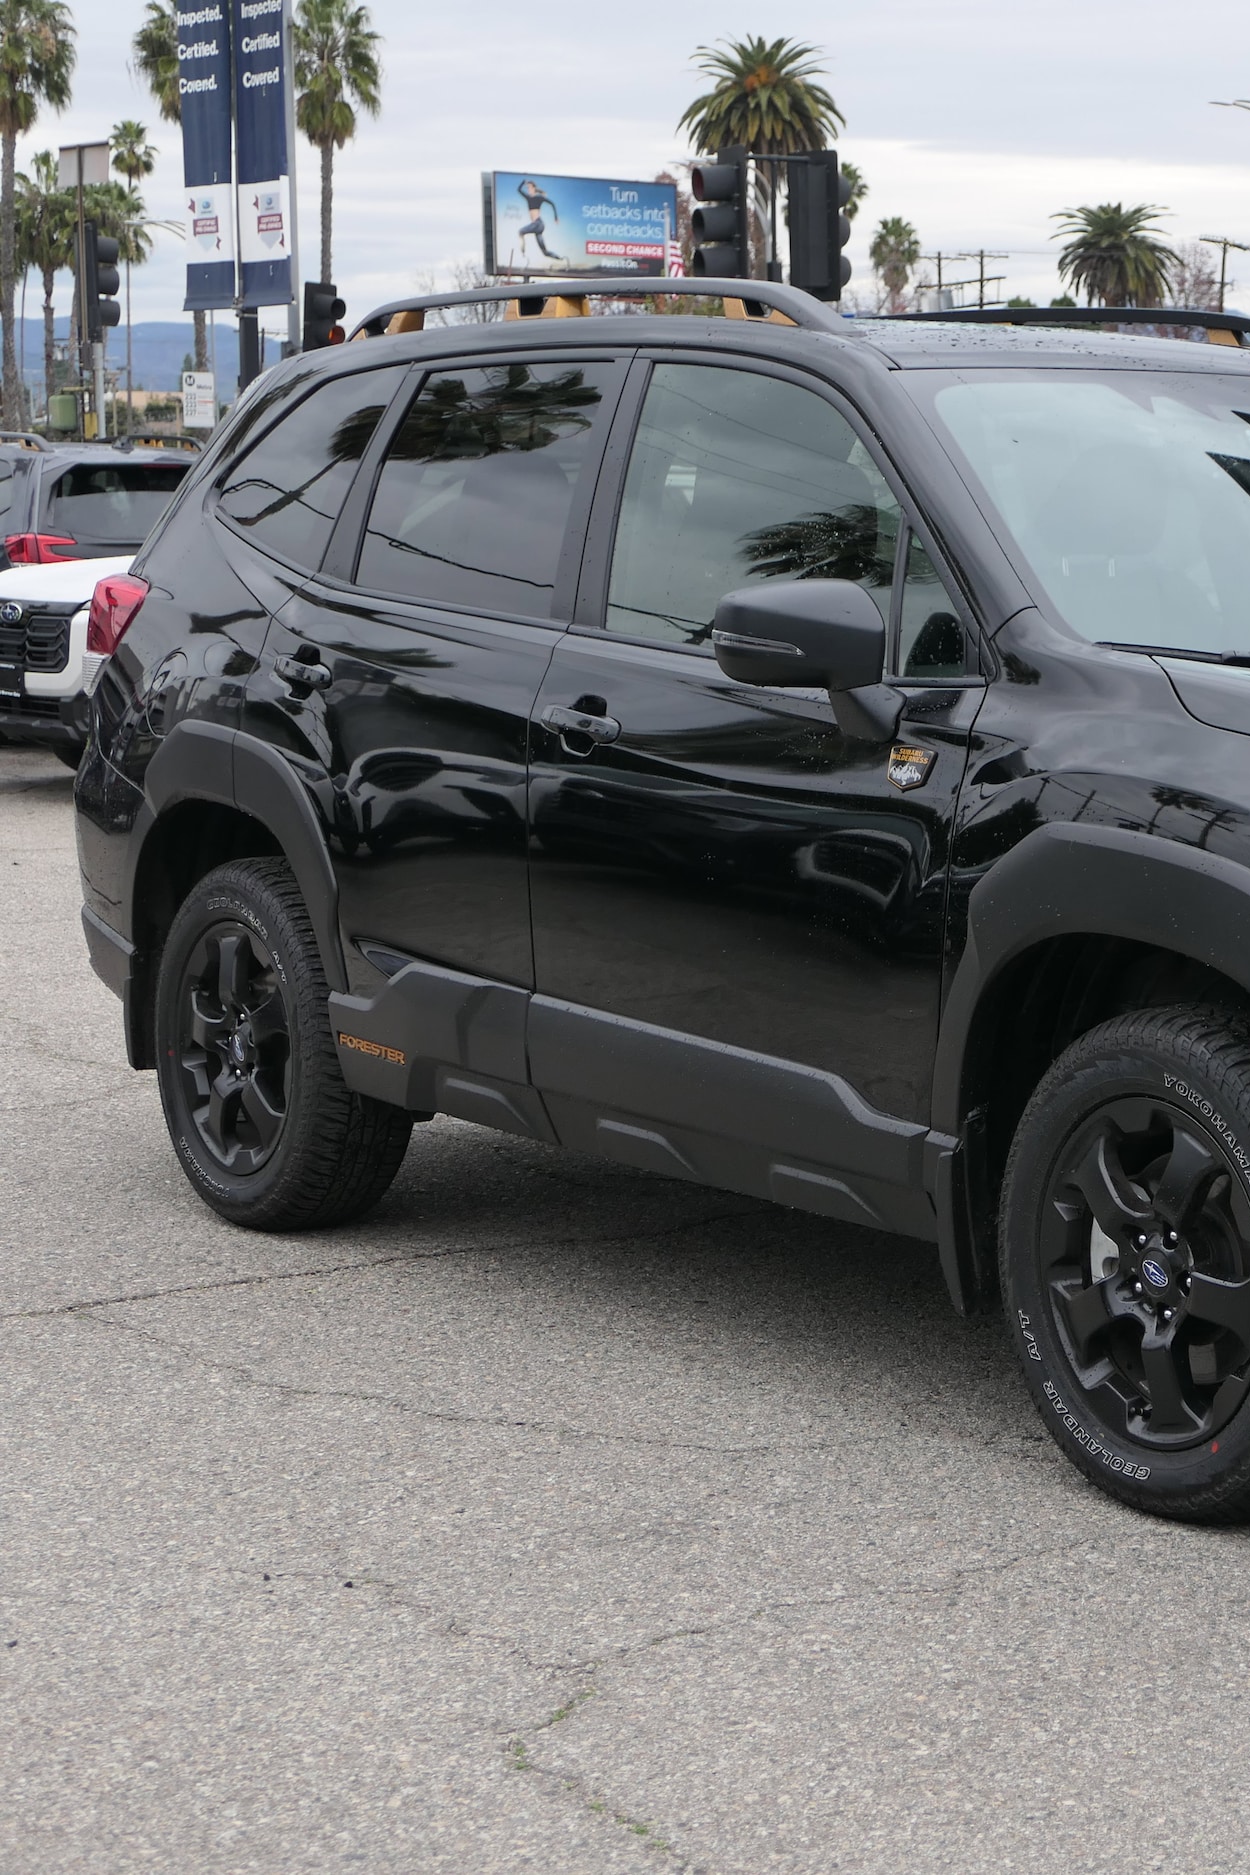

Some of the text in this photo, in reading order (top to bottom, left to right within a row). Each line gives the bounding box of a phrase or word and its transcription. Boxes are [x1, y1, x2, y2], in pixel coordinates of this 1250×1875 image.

[609, 186, 639, 203] Turn
[582, 204, 640, 222] setbacks
[586, 222, 664, 239] comebacks.
[587, 242, 663, 257] SECOND CHANCE
[339, 1033, 406, 1065] FORESTER
[1018, 1309, 1041, 1361] A/T
[1042, 1380, 1151, 1480] GEOLANDAR
